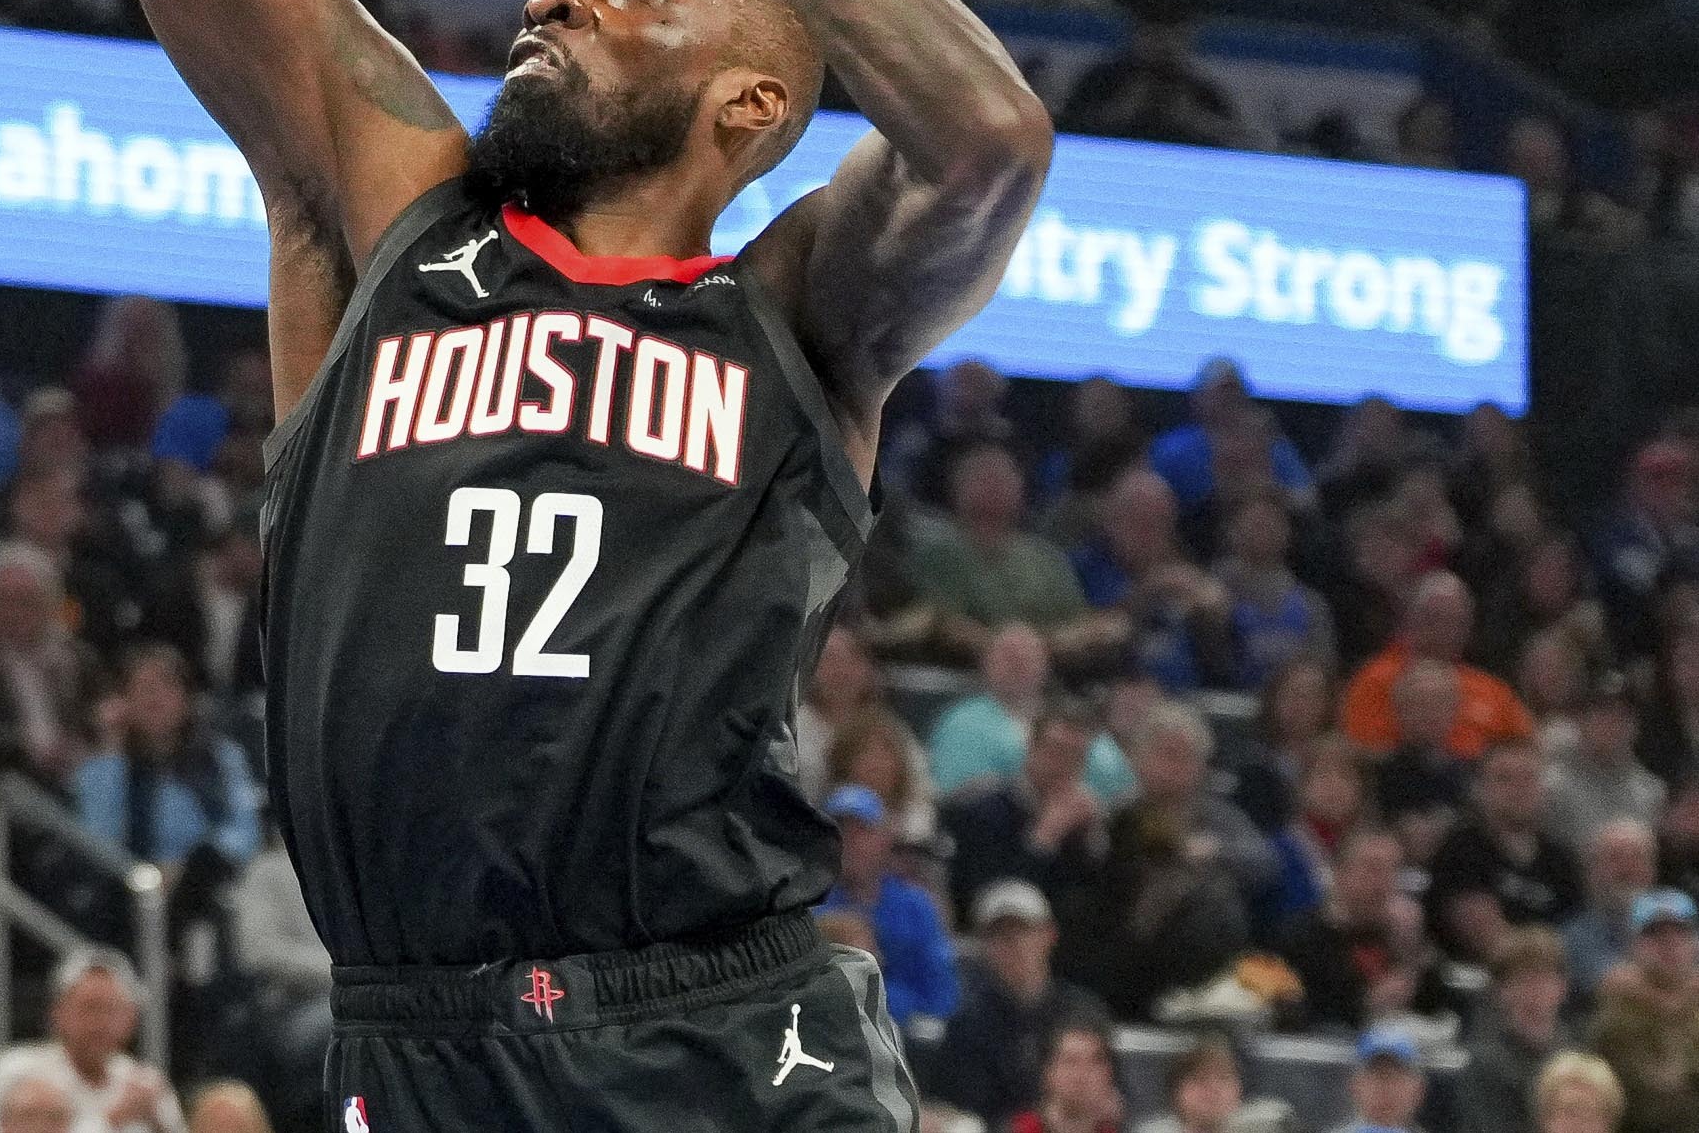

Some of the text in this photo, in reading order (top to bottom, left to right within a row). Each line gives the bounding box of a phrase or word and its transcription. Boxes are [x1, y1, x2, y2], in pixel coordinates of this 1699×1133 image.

[1194, 216, 1505, 365] Strong
[355, 310, 749, 488] HOUSTON
[432, 486, 604, 679] 32
